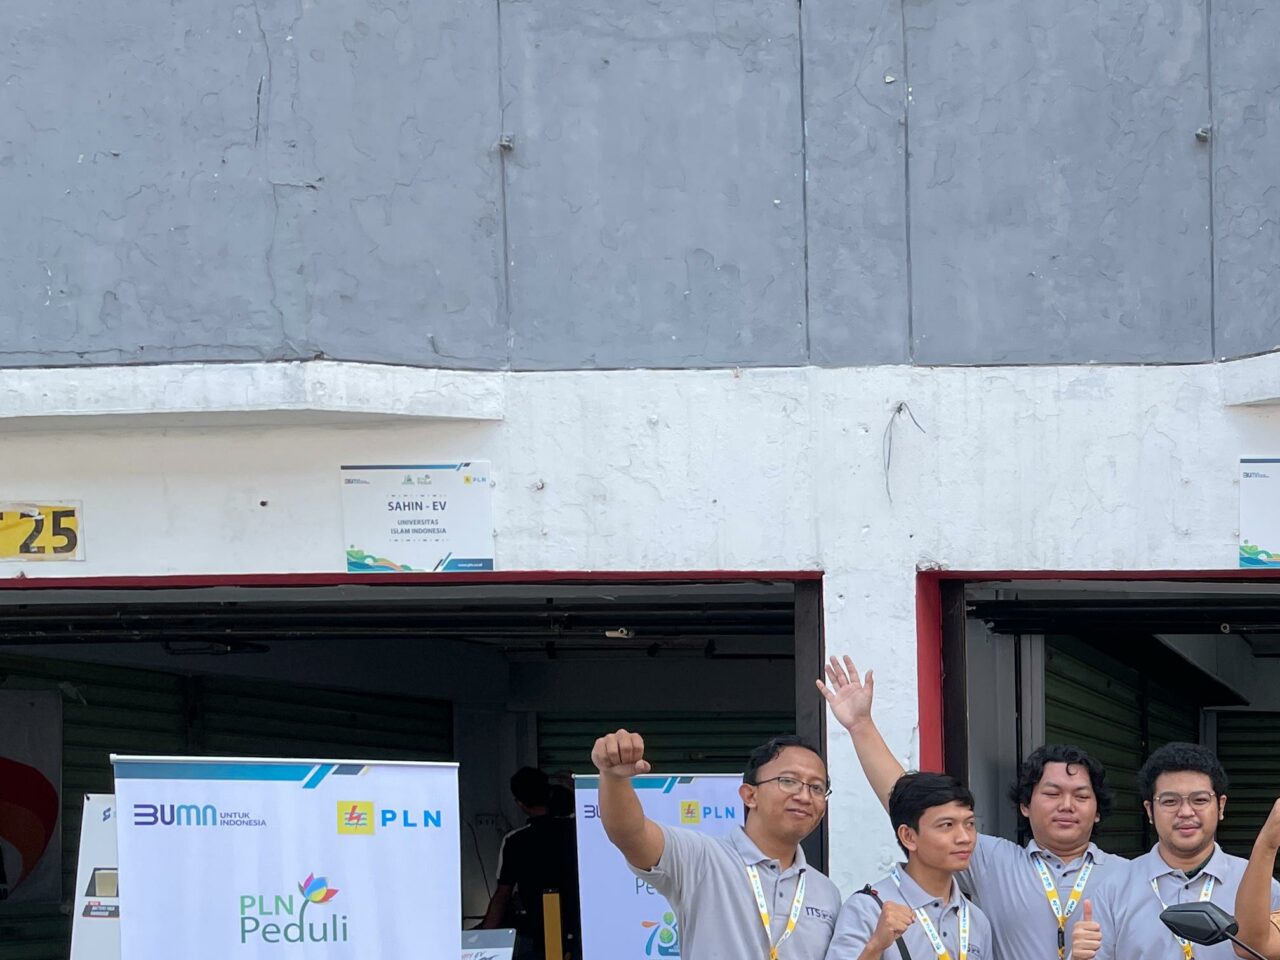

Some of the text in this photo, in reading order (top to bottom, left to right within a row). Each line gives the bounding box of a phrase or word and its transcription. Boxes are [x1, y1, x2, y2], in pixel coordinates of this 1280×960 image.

[388, 501, 423, 511] SAHIN
[432, 501, 447, 511] EV
[381, 809, 442, 828] PLN
[703, 806, 735, 819] PLN
[240, 894, 294, 916] PLN
[240, 913, 348, 944] Peduli
